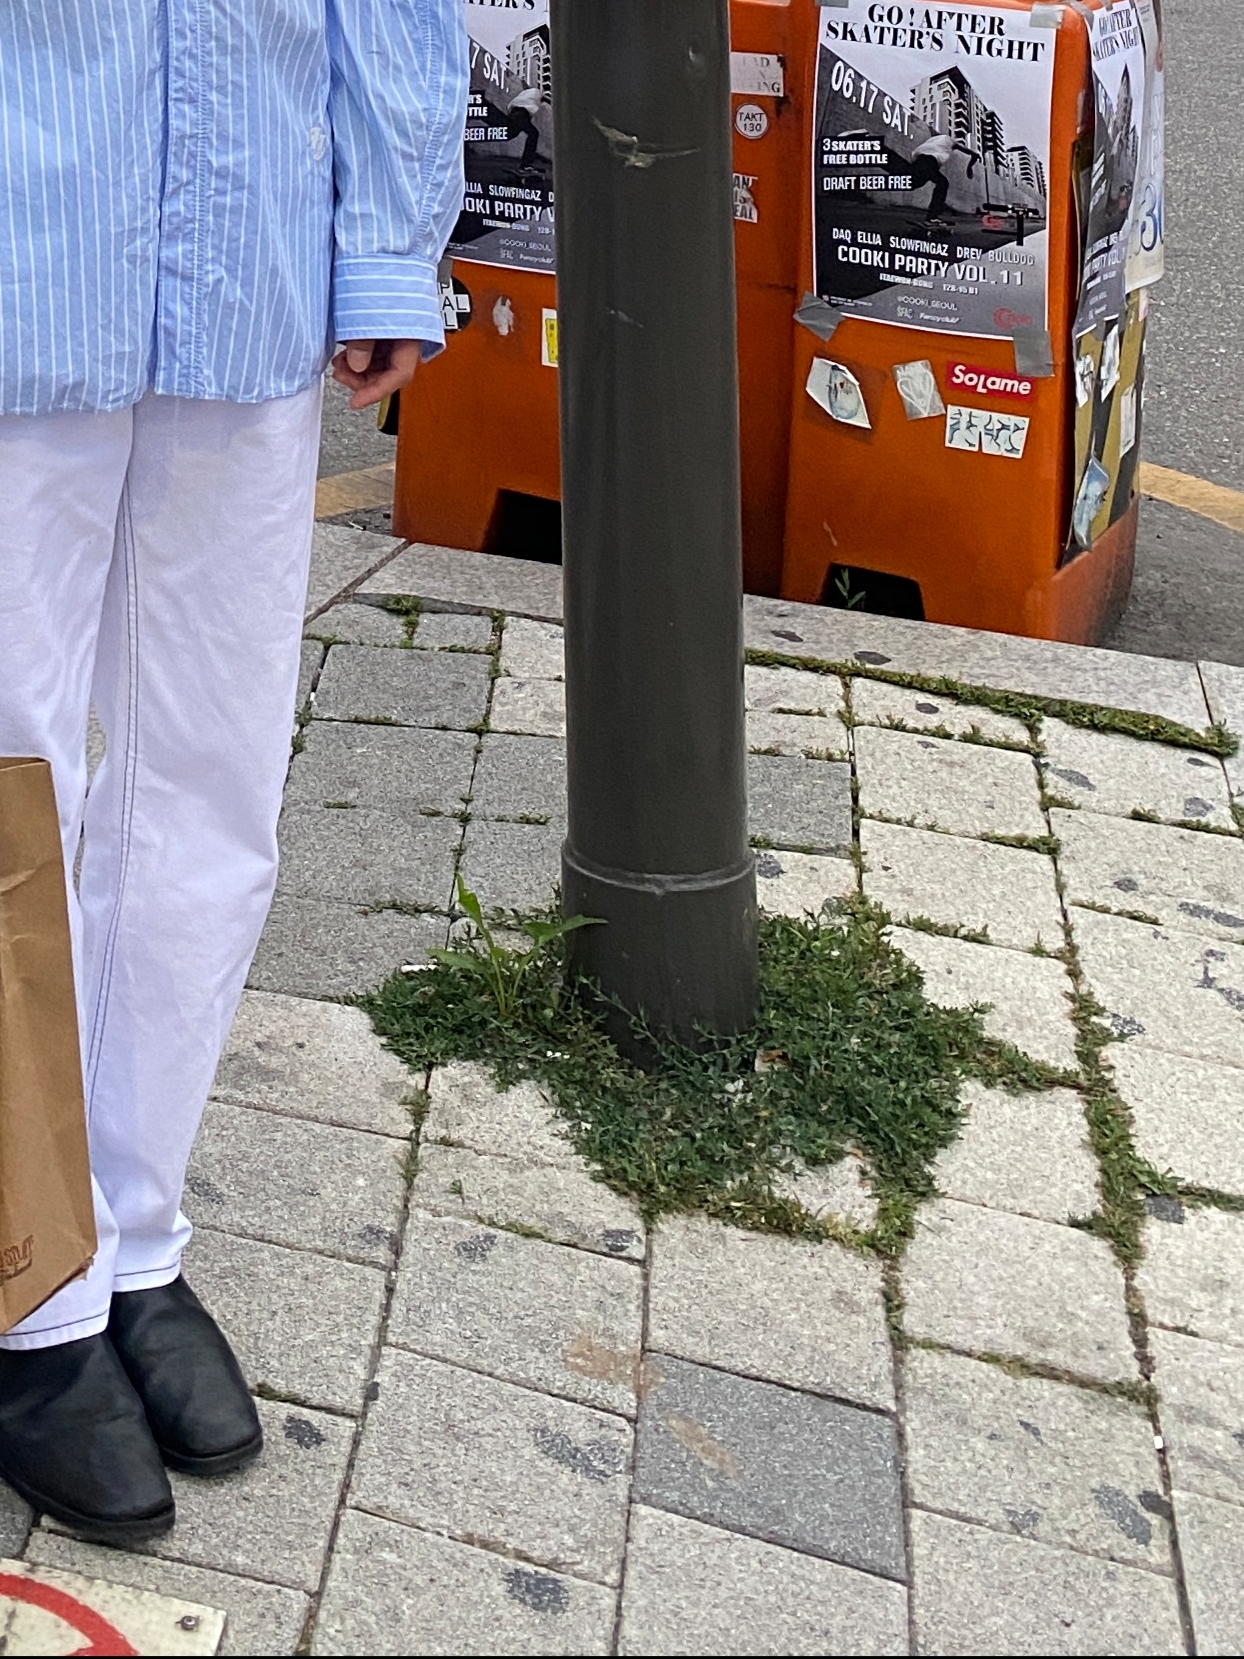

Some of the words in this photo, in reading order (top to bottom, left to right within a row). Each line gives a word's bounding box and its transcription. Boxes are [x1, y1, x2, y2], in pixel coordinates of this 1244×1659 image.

[825, 19, 944, 52] SKATER'S
[954, 33, 1045, 63] NIGHT
[831, 60, 878, 113] 06.17
[883, 95, 914, 139] SAT.
[738, 111, 764, 123] TAKT
[743, 121, 762, 132] 130
[487, 126, 509, 140] FREE
[822, 153, 847, 165] FREE
[849, 153, 888, 165] BOTTLE
[488, 184, 542, 201] SLOWFINGAZ
[823, 176, 857, 191] DRAFT
[859, 175, 886, 190] BEER
[888, 175, 913, 189] FREE
[494, 200, 543, 222] PARTY
[832, 227, 852, 243] DAQ
[857, 230, 882, 246] ELLIA
[889, 236, 949, 257] SLOWFINGAZ
[956, 246, 983, 260] DREV
[988, 249, 1036, 266] BULLDOG
[837, 244, 889, 269] COOKI
[894, 252, 950, 278] PARTY
[951, 364, 1032, 395] SoLame
